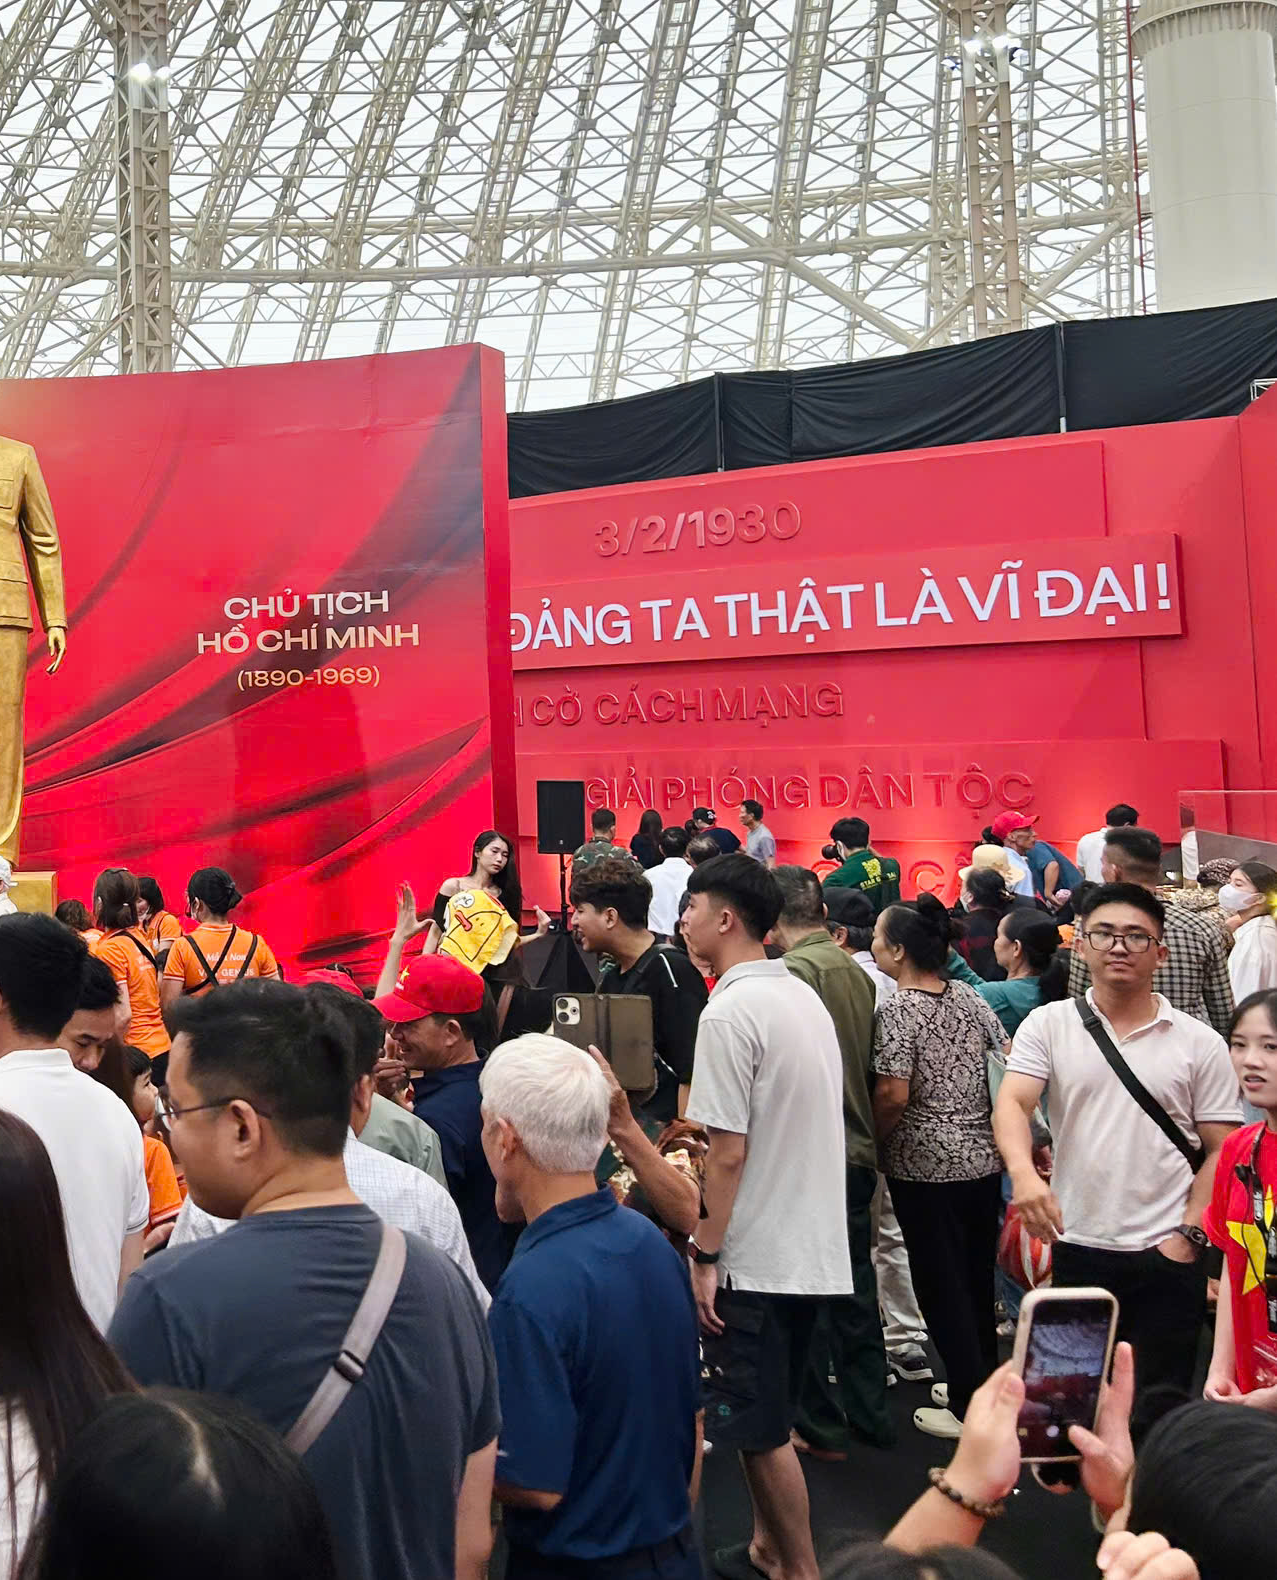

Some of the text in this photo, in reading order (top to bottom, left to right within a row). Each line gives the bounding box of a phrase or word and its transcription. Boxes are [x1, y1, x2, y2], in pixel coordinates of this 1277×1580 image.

[594, 501, 802, 557] 3/2/1930
[224, 588, 389, 620] CHỦ TỊCH
[510, 559, 1171, 651] ĐẢNG TA THẬT LÀ VĨ ĐẠI!
[197, 622, 420, 654] HỒ CHÍ MINH
[237, 664, 380, 691] (1890-1969)
[530, 684, 583, 726] CỜ
[594, 681, 704, 725] CÁCH
[714, 681, 844, 727] MẠNG
[586, 763, 1035, 819] GIẢI PHÓNG DÂN TỘC
